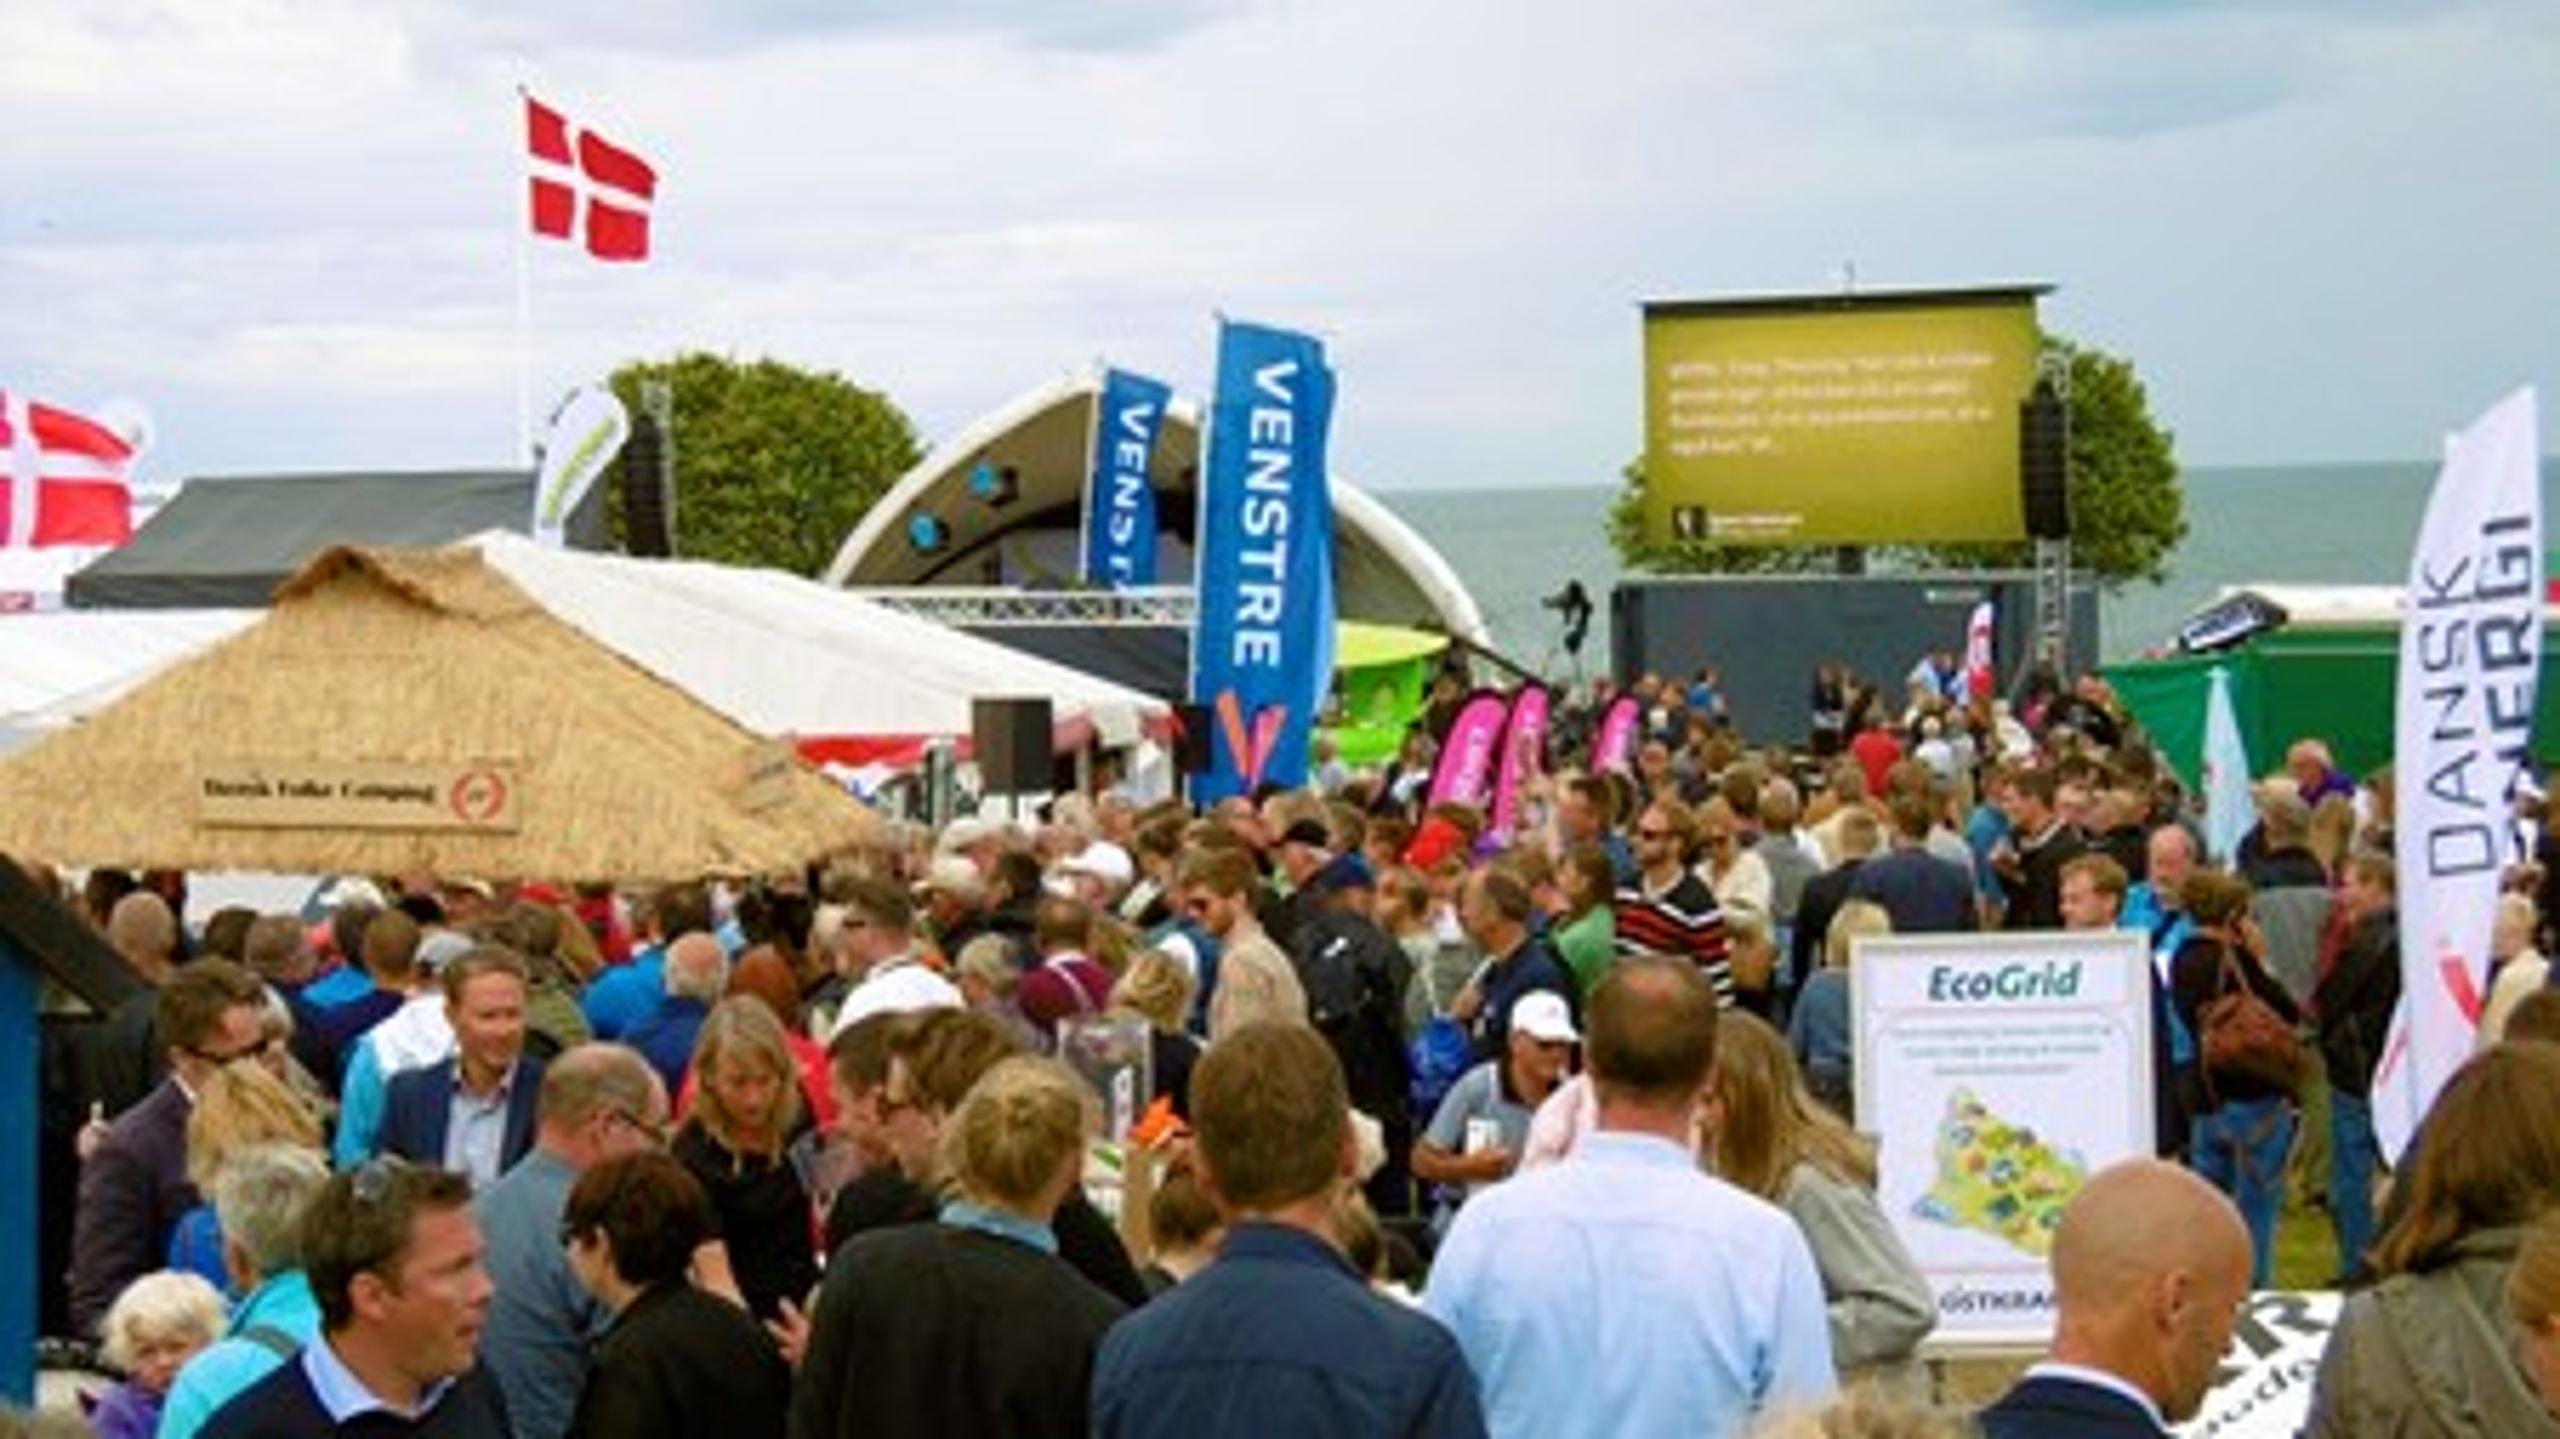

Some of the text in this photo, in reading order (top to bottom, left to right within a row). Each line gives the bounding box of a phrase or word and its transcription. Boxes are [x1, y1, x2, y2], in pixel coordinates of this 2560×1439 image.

[1107, 402, 1155, 592] VENST
[1233, 361, 1298, 667] VENSTRE
[2418, 555, 2496, 878] DANSK
[1928, 960, 2083, 1001] EcoGrid
[1939, 1283, 2056, 1314] ØSTKRA
